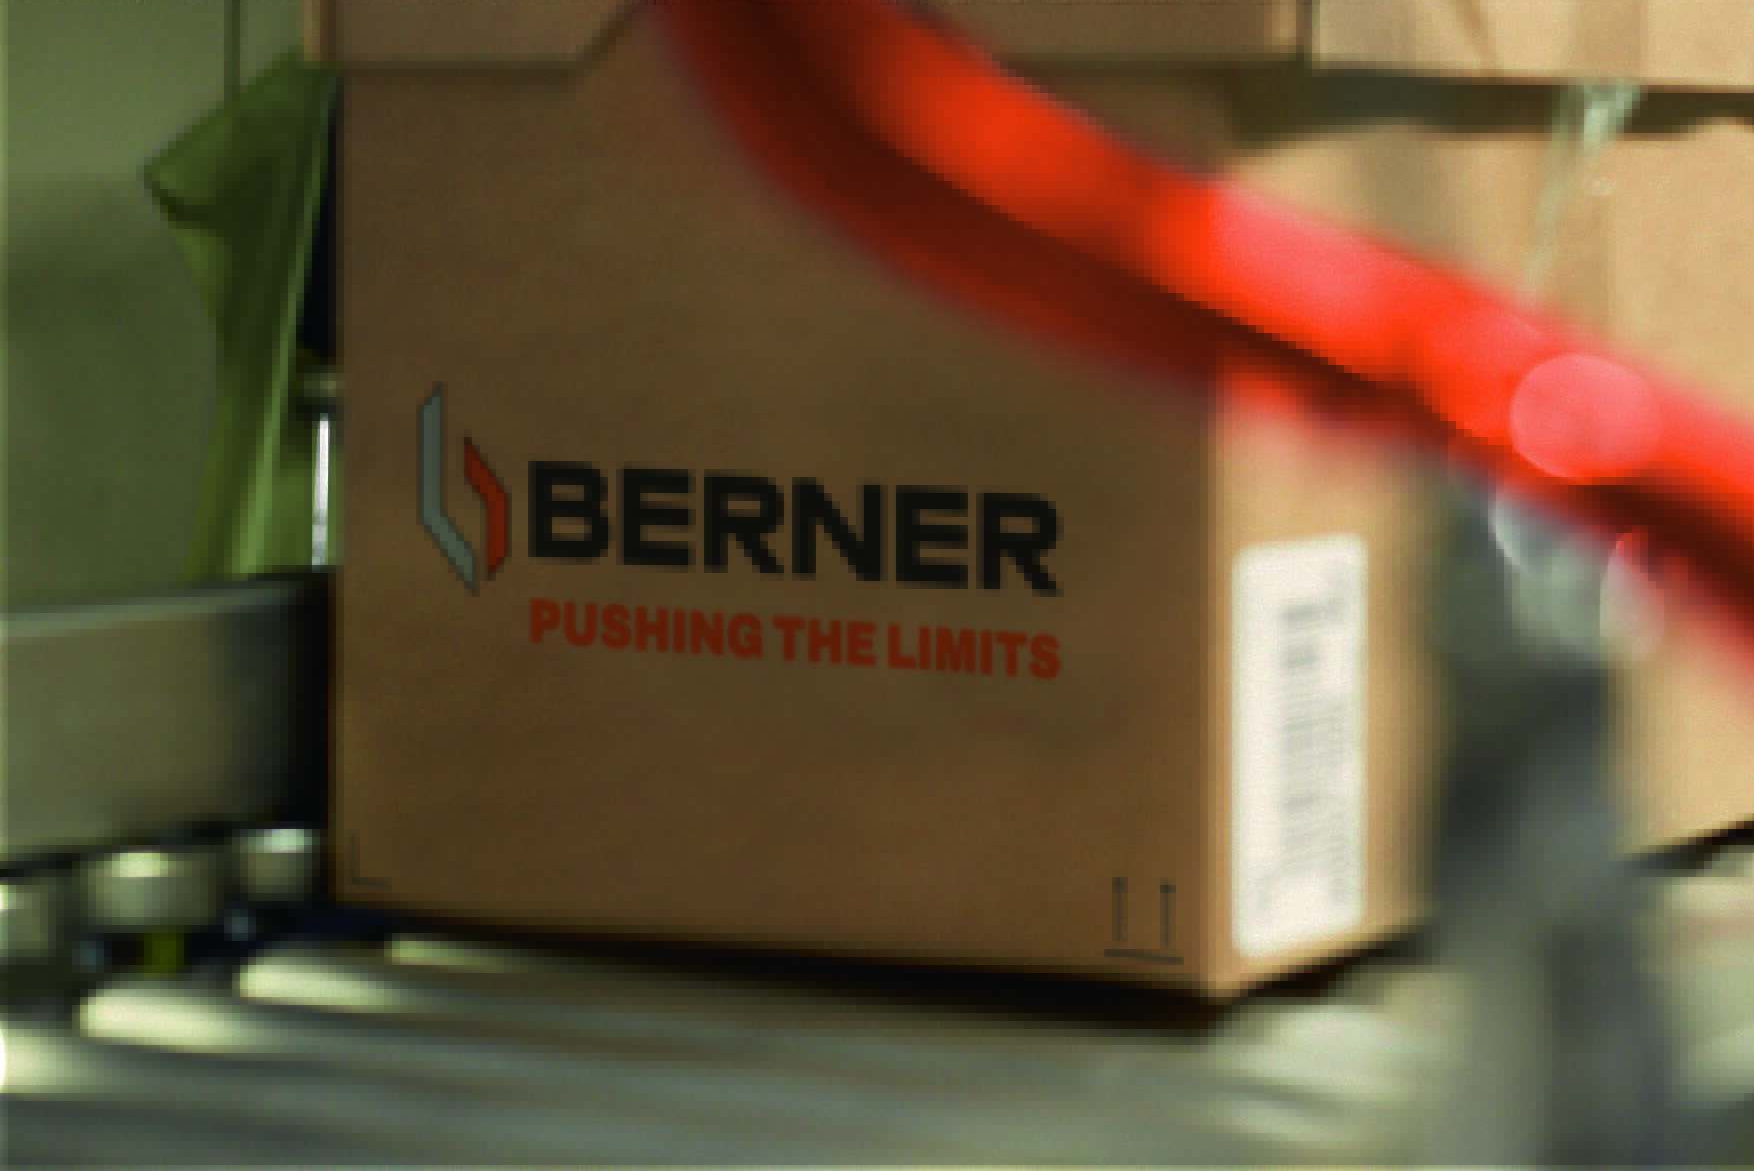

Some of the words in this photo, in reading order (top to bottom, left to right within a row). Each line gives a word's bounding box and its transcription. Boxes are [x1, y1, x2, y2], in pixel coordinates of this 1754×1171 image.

[528, 461, 1062, 597] BERNER
[529, 598, 764, 660] PUSHING
[772, 614, 877, 667] THE
[887, 623, 1062, 679] LIMITS
